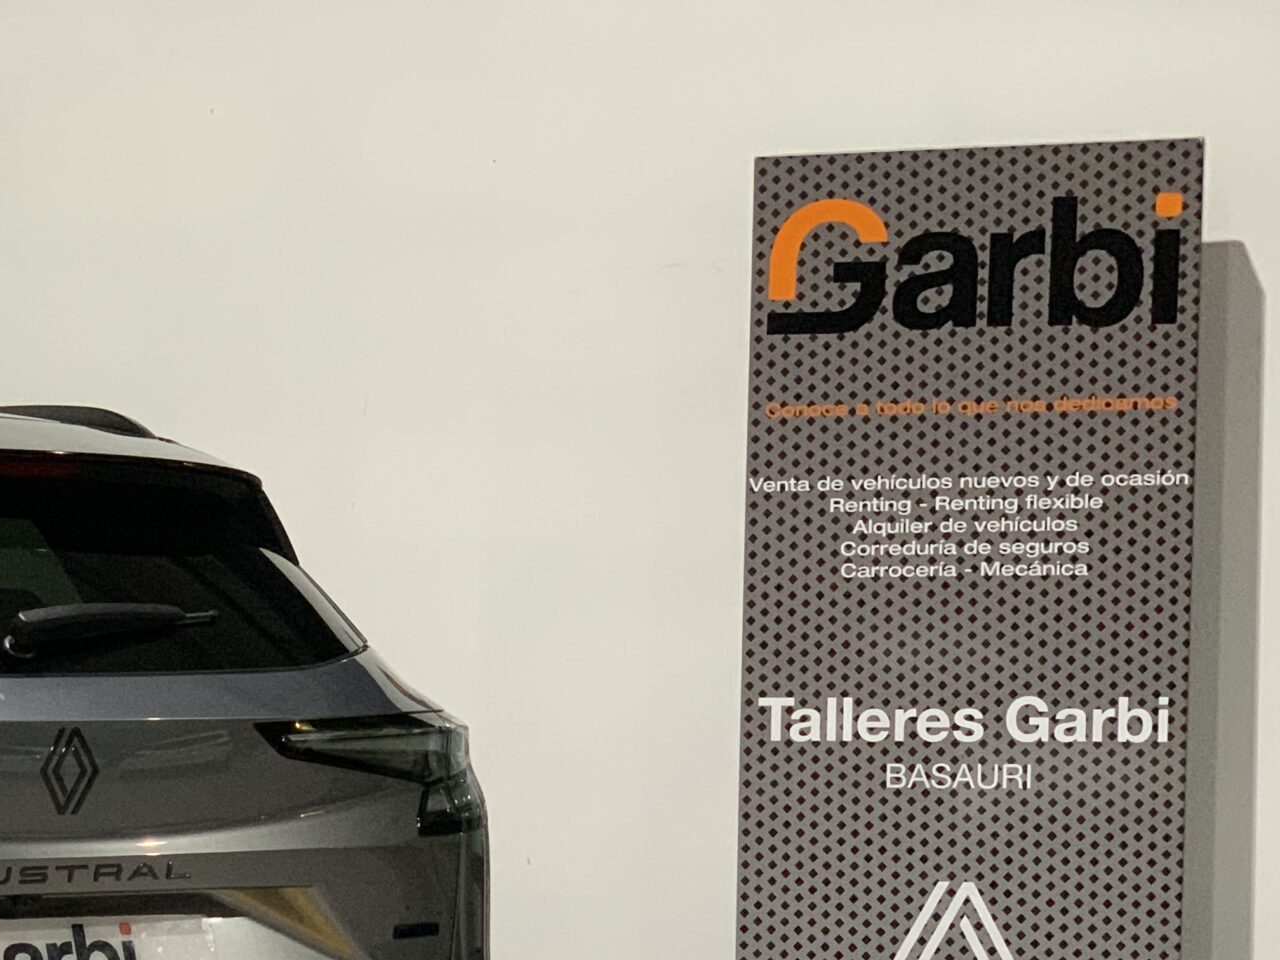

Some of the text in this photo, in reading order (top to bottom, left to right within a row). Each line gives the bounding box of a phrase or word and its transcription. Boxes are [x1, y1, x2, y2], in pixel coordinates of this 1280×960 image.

[766, 192, 1184, 336] Garbi
[876, 399, 925, 416] todo
[932, 399, 951, 415] lo
[957, 399, 999, 416] que
[1007, 399, 1046, 413] nos
[1053, 395, 1179, 413] dedicamos
[749, 470, 1190, 492] Venta de vehículos nuevos y de ocasión
[829, 497, 912, 515] Renting
[935, 495, 1019, 513] Renting
[1025, 494, 1104, 509] flexible
[852, 516, 1079, 537] Alquiler de vehículos
[840, 540, 1090, 557] Correduría de seguros
[840, 562, 957, 578] Carrocería
[980, 561, 1089, 577] Mecánica
[758, 695, 1170, 743] Talleres Garbi
[885, 763, 1033, 790] BASAURI
